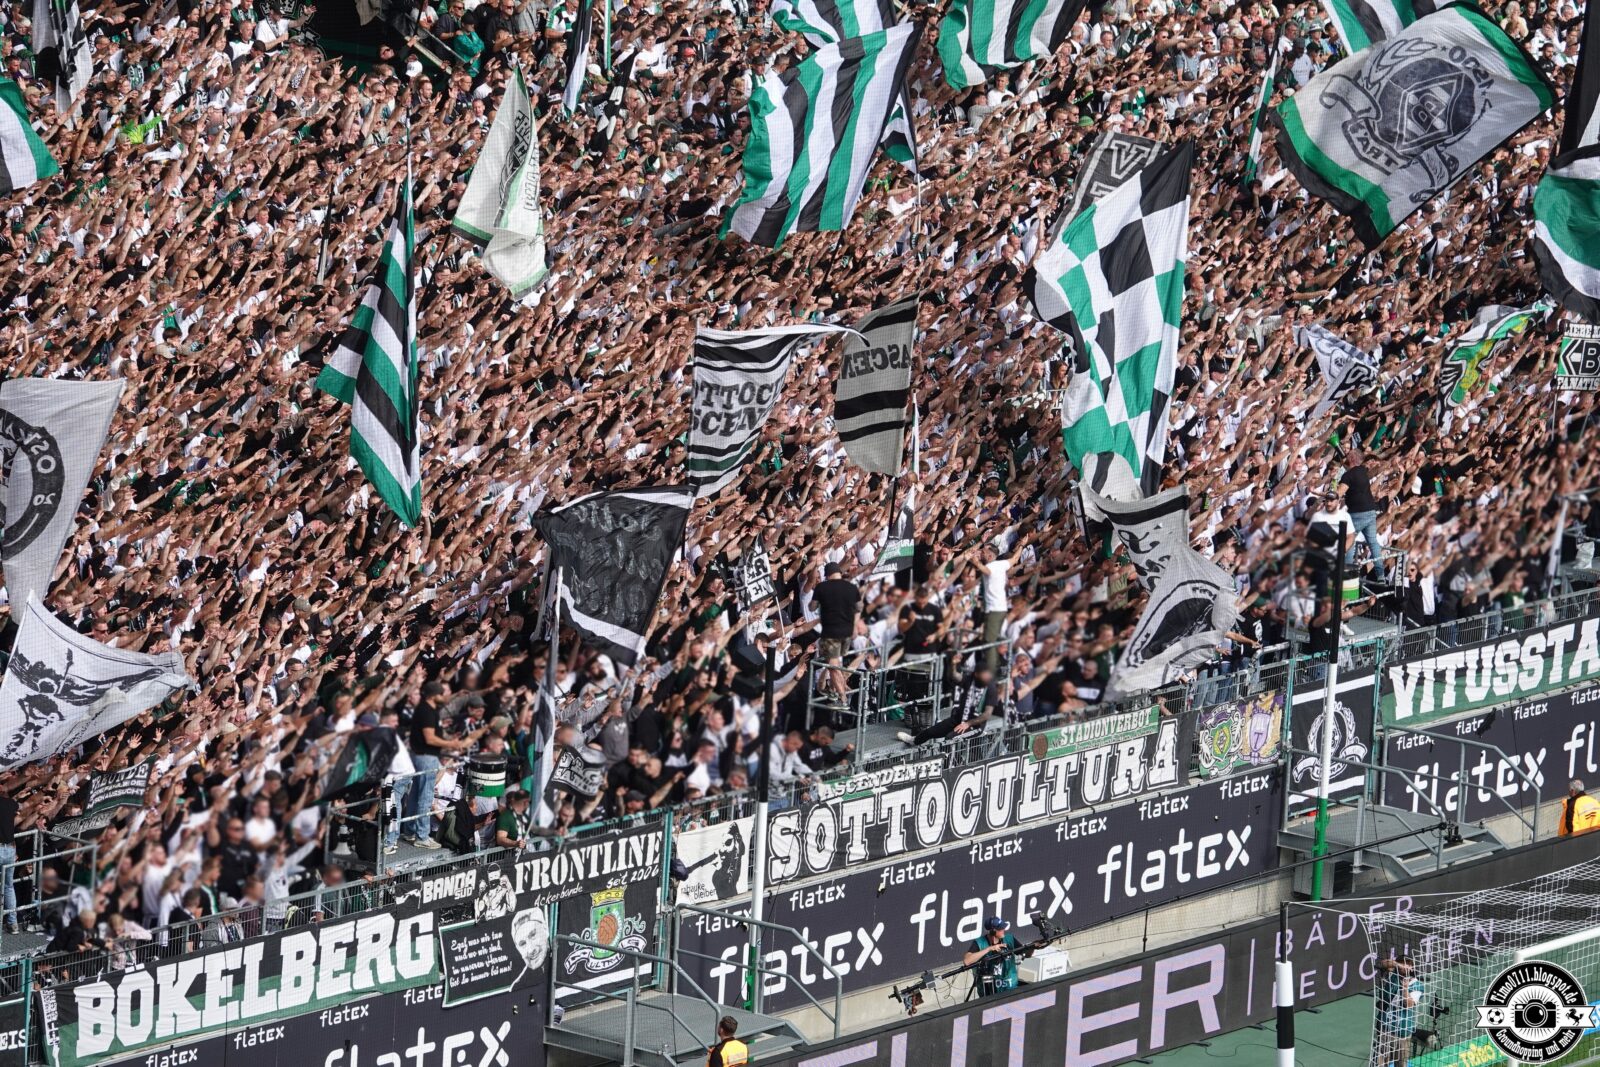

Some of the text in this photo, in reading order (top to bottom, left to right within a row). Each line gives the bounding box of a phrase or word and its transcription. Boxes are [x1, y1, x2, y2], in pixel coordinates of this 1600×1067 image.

[1513, 702, 1548, 721] flatex
[1060, 708, 1153, 746] STADIONVERBOT
[823, 757, 944, 801] ASCENDENTE
[1218, 774, 1269, 801] flatex
[1405, 747, 1548, 816] flatex
[768, 717, 1180, 884] SOTTOCULTURA
[1138, 795, 1190, 822] flatex
[1055, 816, 1108, 843] flatex
[513, 830, 664, 895] FRONTLINE
[969, 838, 1023, 865] flatex
[1097, 824, 1252, 903] flatex
[422, 868, 477, 904] BANDA
[880, 860, 936, 888] flatex
[789, 883, 846, 912] flatex
[910, 871, 1075, 954] flatex
[73, 911, 438, 1059] BÖKELBERG
[319, 1002, 370, 1028] flatex
[234, 1024, 286, 1051] flatex
[145, 1047, 199, 1067] flatex
